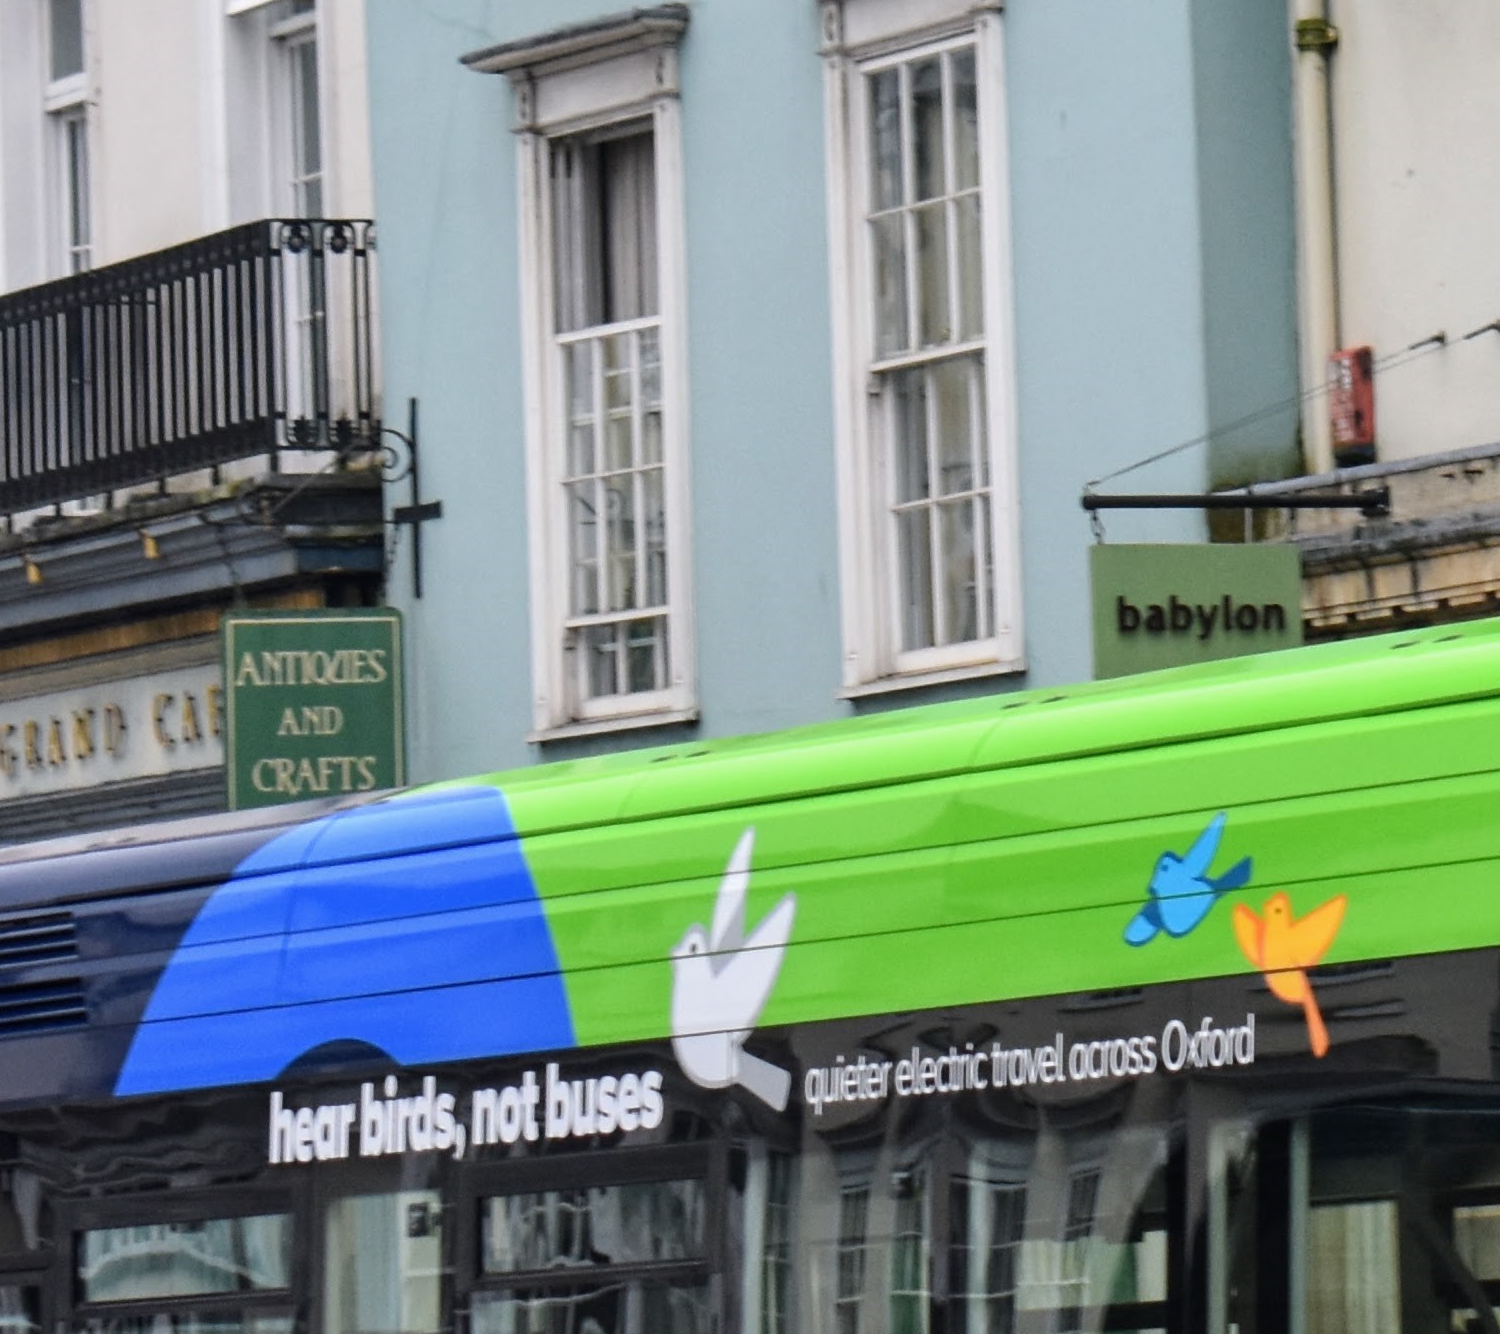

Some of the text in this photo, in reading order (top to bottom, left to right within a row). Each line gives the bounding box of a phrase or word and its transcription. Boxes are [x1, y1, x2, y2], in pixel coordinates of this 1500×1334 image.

[1116, 595, 1286, 641] babylon
[235, 649, 388, 687] ANTIQUES
[151, 683, 224, 748] CAF
[277, 706, 344, 737] AND
[252, 757, 377, 796] CRAFTS
[804, 1013, 1256, 1114] quieter electric travel across Oxford
[268, 1063, 664, 1164] hear birds, not buses
